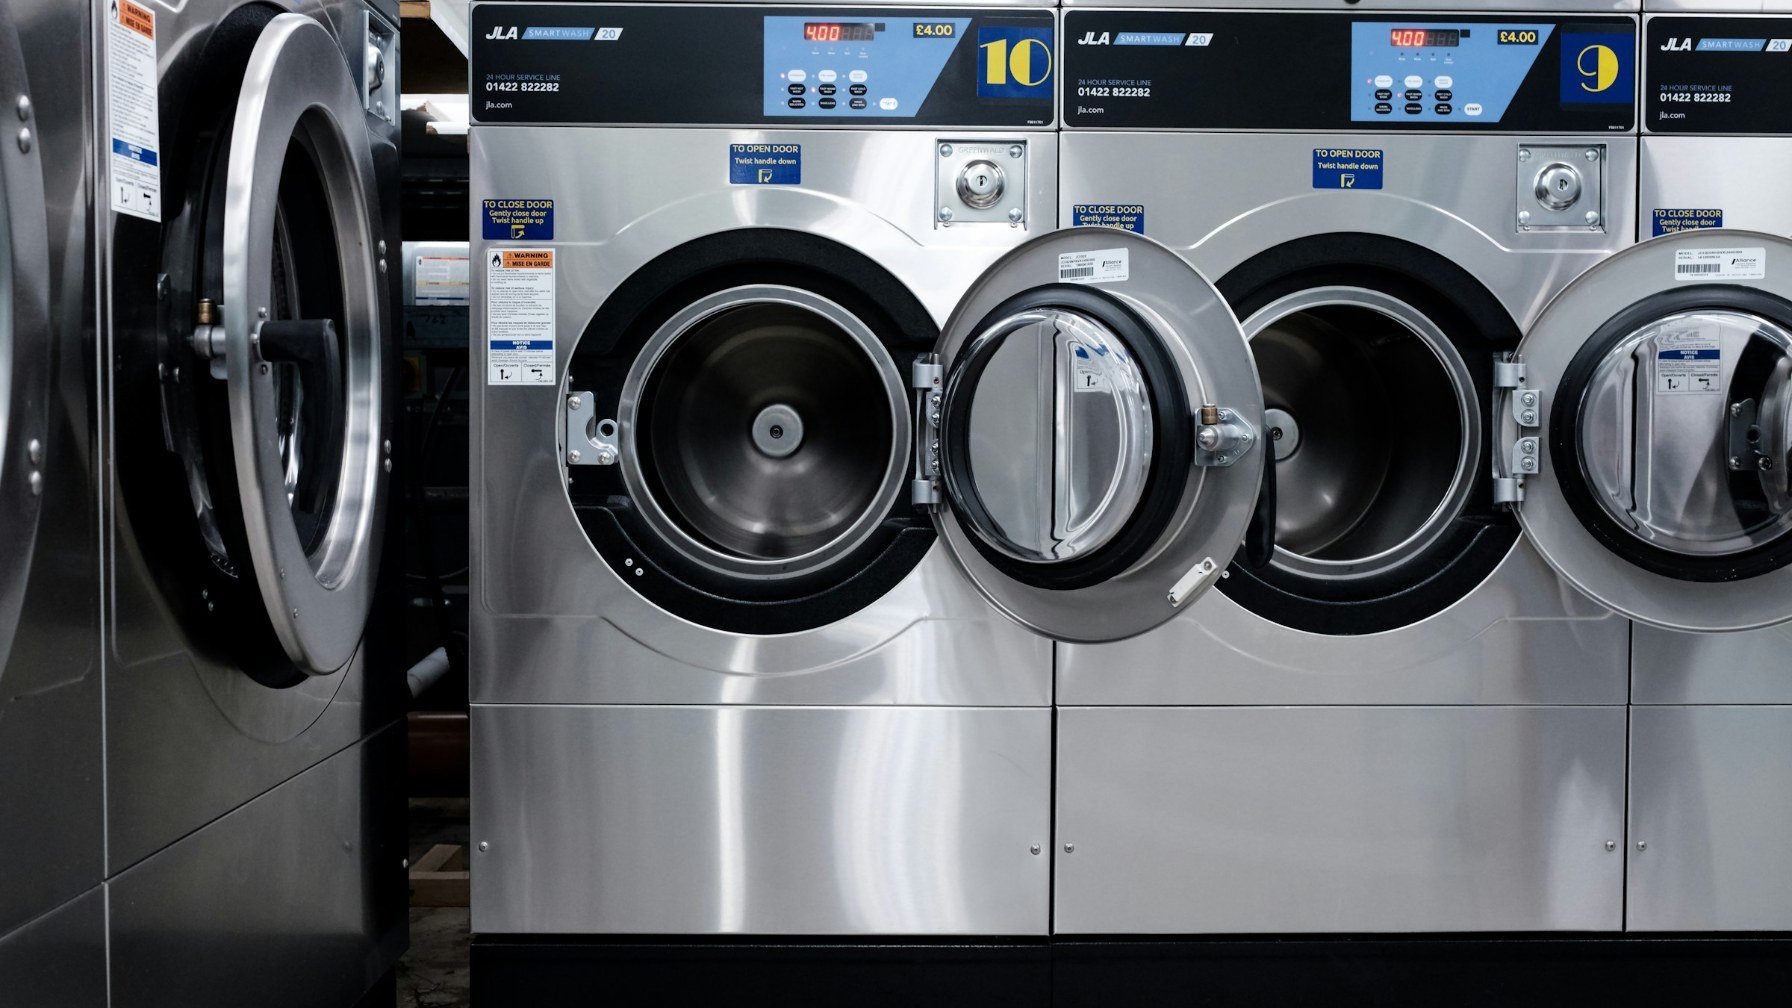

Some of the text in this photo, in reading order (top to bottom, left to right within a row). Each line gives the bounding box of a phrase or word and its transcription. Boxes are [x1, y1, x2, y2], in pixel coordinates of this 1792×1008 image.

[486, 26, 517, 40] JLA
[602, 30, 616, 38] 20
[916, 24, 952, 36] £4.00
[1077, 32, 1110, 45] JLA
[1192, 35, 1206, 44] 20
[1500, 32, 1536, 42] £4.00
[1660, 38, 1691, 51] JLA
[1772, 41, 1786, 50] 20
[980, 39, 1052, 86] 10
[1577, 44, 1619, 93] 9
[486, 82, 559, 92] 01422 822282
[1078, 87, 1150, 97] 01422 822282
[1660, 93, 1731, 102] 01422 822282
[485, 101, 513, 110] jla.com
[1077, 106, 1104, 115] jla.com
[1659, 110, 1686, 120] jla.com
[773, 145, 798, 153] DOOR
[1330, 150, 1353, 158] OPEN
[1355, 150, 1380, 158] DOOR
